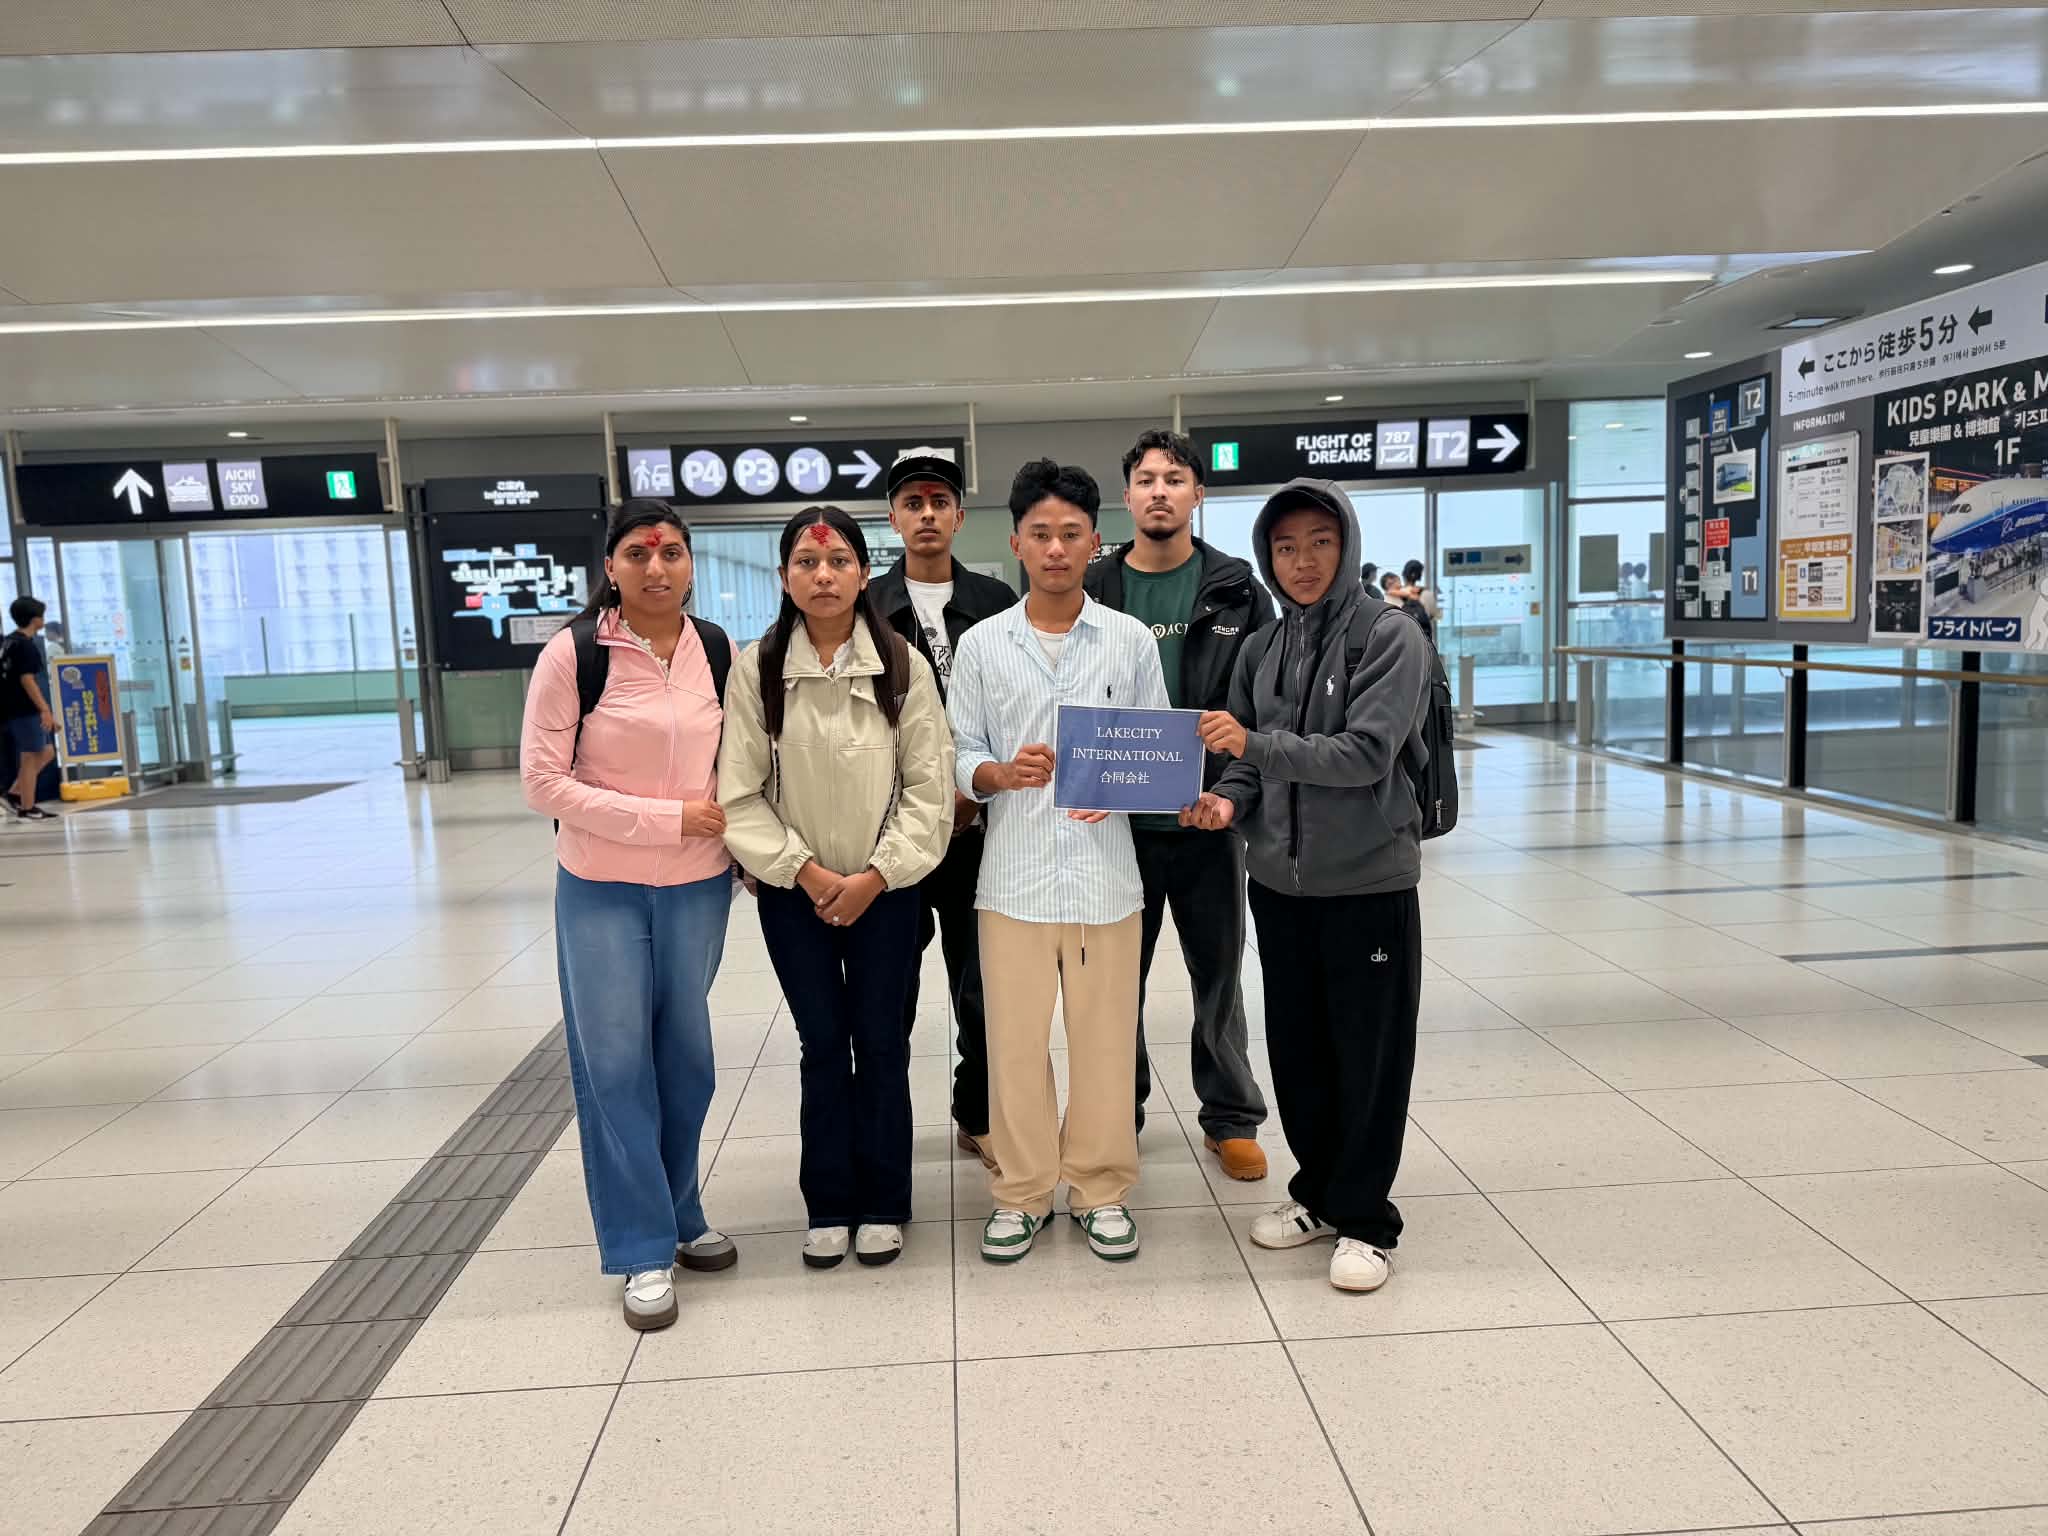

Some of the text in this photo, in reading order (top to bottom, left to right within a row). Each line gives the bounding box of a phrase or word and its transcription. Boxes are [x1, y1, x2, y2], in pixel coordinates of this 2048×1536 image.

[1824, 314, 1958, 373] ここから徒歩5分
[1744, 387, 1761, 410] T2
[1788, 385, 1824, 402] 5-minute
[1825, 381, 1839, 392] walk
[1840, 378, 1856, 388] from
[1887, 393, 1936, 427] KIDS
[1943, 377, 2009, 416] PARK
[2013, 381, 2027, 401] &
[1793, 410, 1845, 432] INFORMATION
[1953, 424, 1962, 438] &
[1296, 433, 1372, 450] FLIGHT OF
[1384, 431, 1411, 443] 787
[1428, 431, 1467, 459] T2
[1308, 448, 1372, 464] DREAMS
[1994, 437, 2021, 465] 1F
[225, 469, 256, 480] AICHI
[685, 459, 723, 488] P4
[737, 457, 774, 487] P3
[792, 457, 825, 485] P1
[231, 482, 252, 493] SKY
[230, 494, 259, 505] EXPO
[1742, 570, 1758, 591] T1
[1096, 726, 1163, 739] LAKECITY
[1072, 747, 1184, 762] INTERNATIONAL
[1100, 770, 1150, 784] 合同会社
